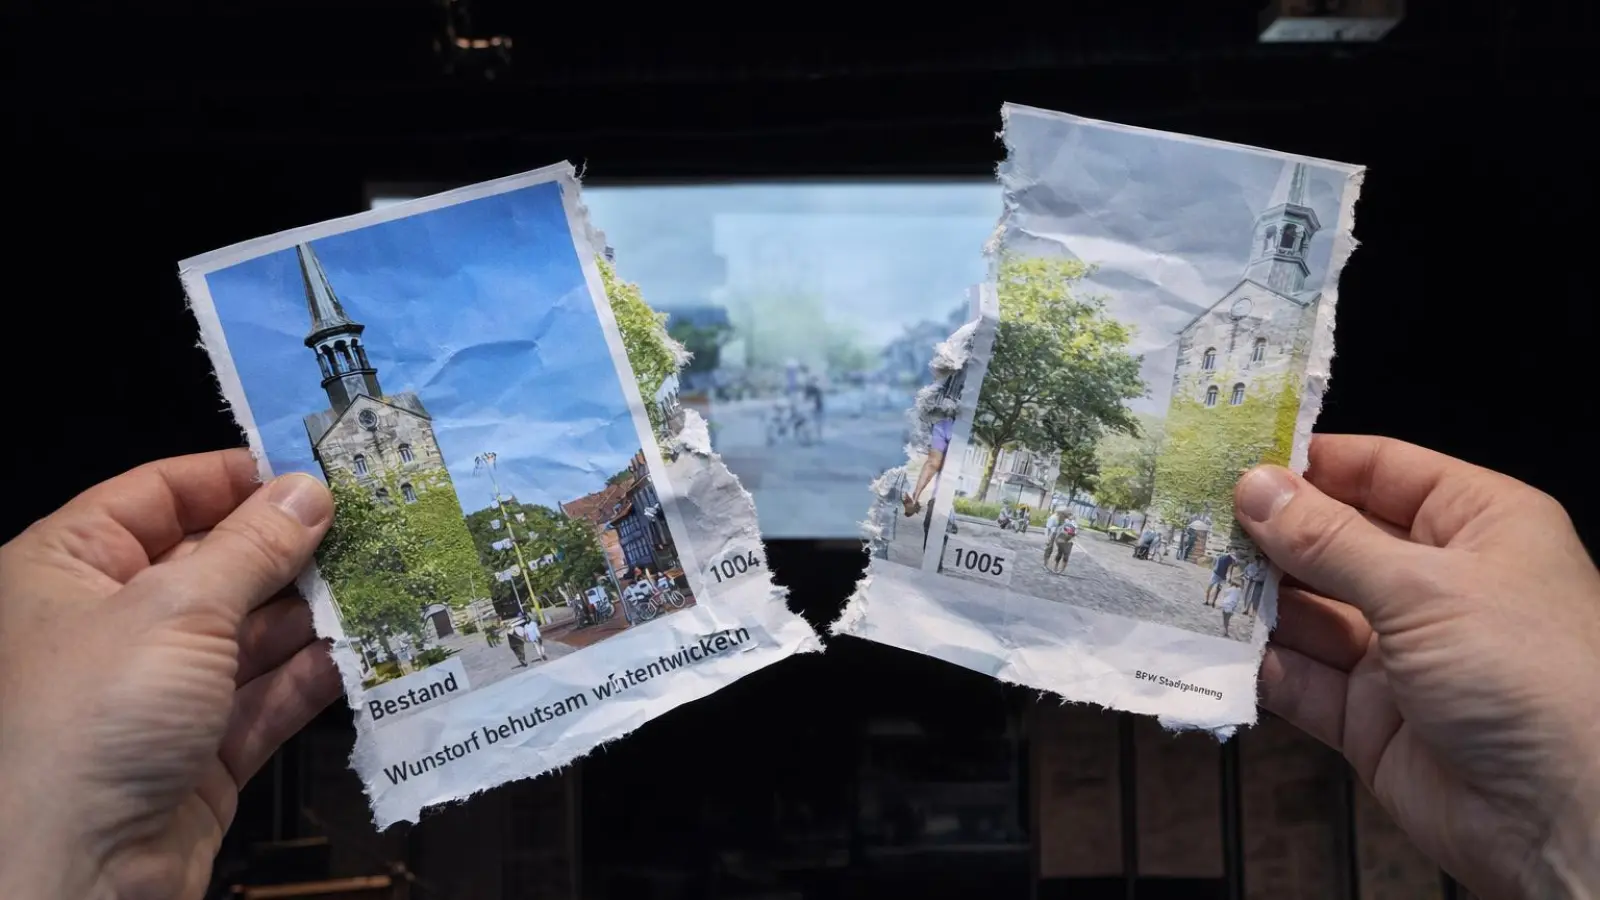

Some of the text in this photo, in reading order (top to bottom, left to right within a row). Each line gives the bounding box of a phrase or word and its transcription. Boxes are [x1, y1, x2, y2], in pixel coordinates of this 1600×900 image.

[710, 551, 760, 583] 1004
[955, 548, 1005, 576] 1005
[369, 672, 459, 721] Bestand
[383, 731, 480, 785] Wunstorf
[483, 692, 588, 745] behutsam
